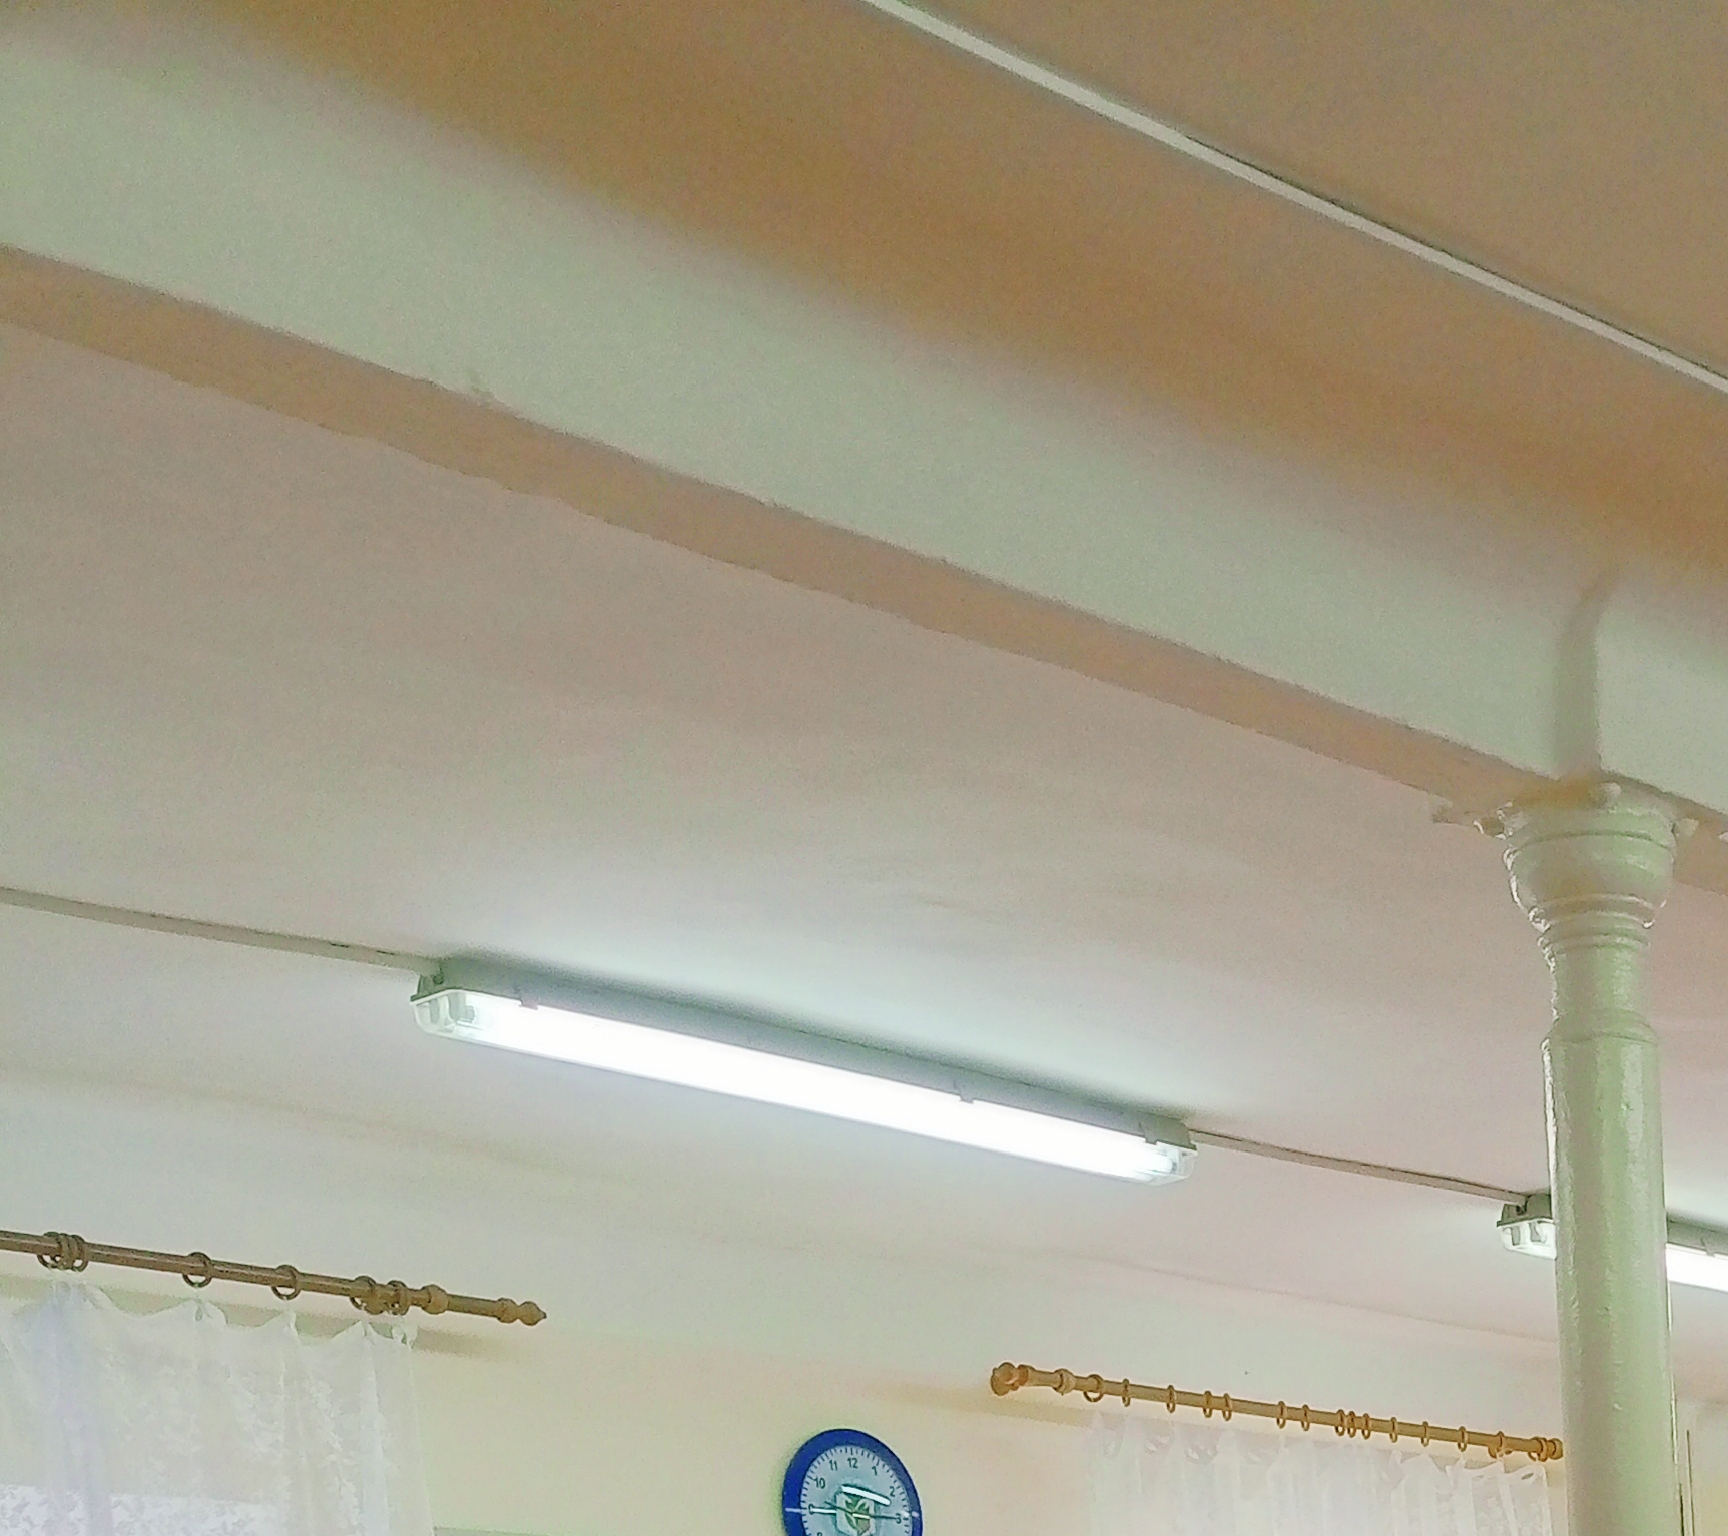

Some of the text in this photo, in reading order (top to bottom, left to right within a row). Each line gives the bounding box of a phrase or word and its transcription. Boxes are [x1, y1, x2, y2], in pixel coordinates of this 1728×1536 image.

[829, 1459, 838, 1471] 11
[847, 1457, 858, 1469] 12
[815, 1477, 826, 1489] 10
